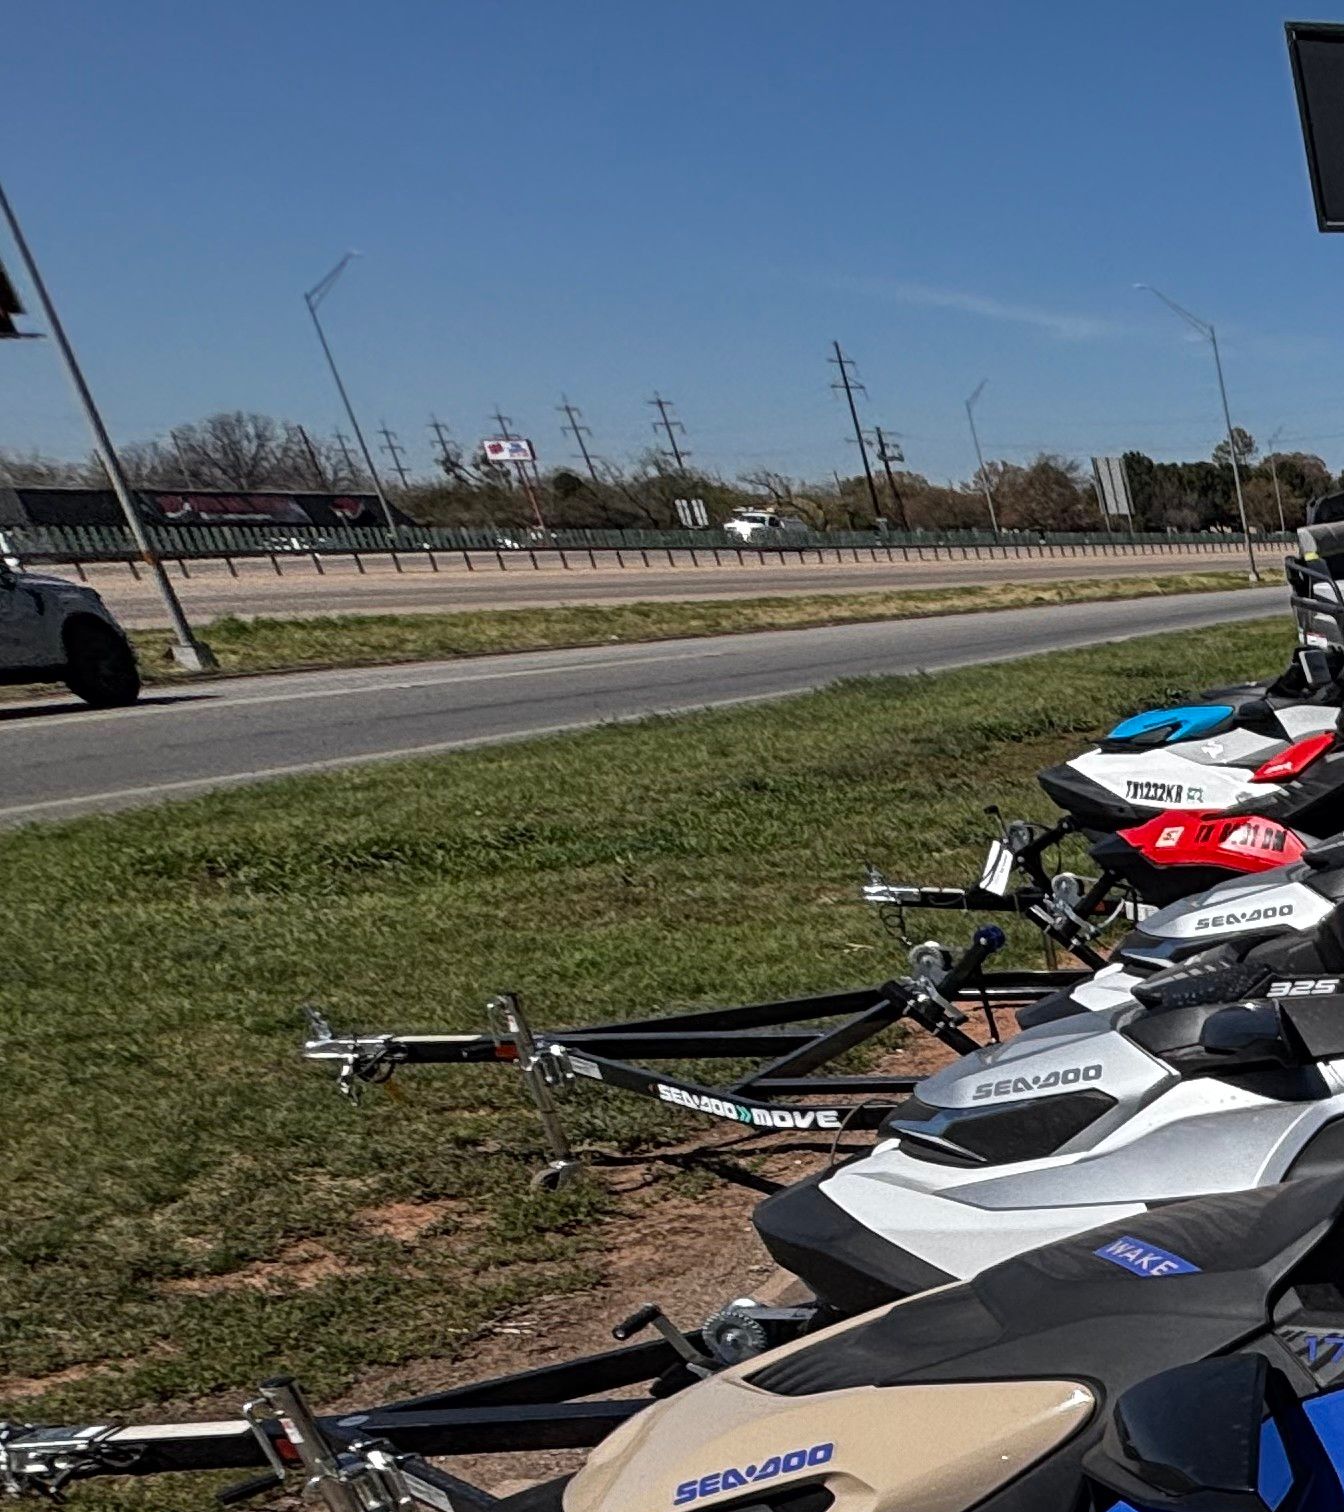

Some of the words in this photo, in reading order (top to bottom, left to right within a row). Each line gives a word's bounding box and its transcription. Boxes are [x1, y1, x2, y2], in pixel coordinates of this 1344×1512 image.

[1267, 979, 1340, 998] 325
[751, 1108, 842, 1129] MOVE
[1105, 1240, 1179, 1277] WAKE
